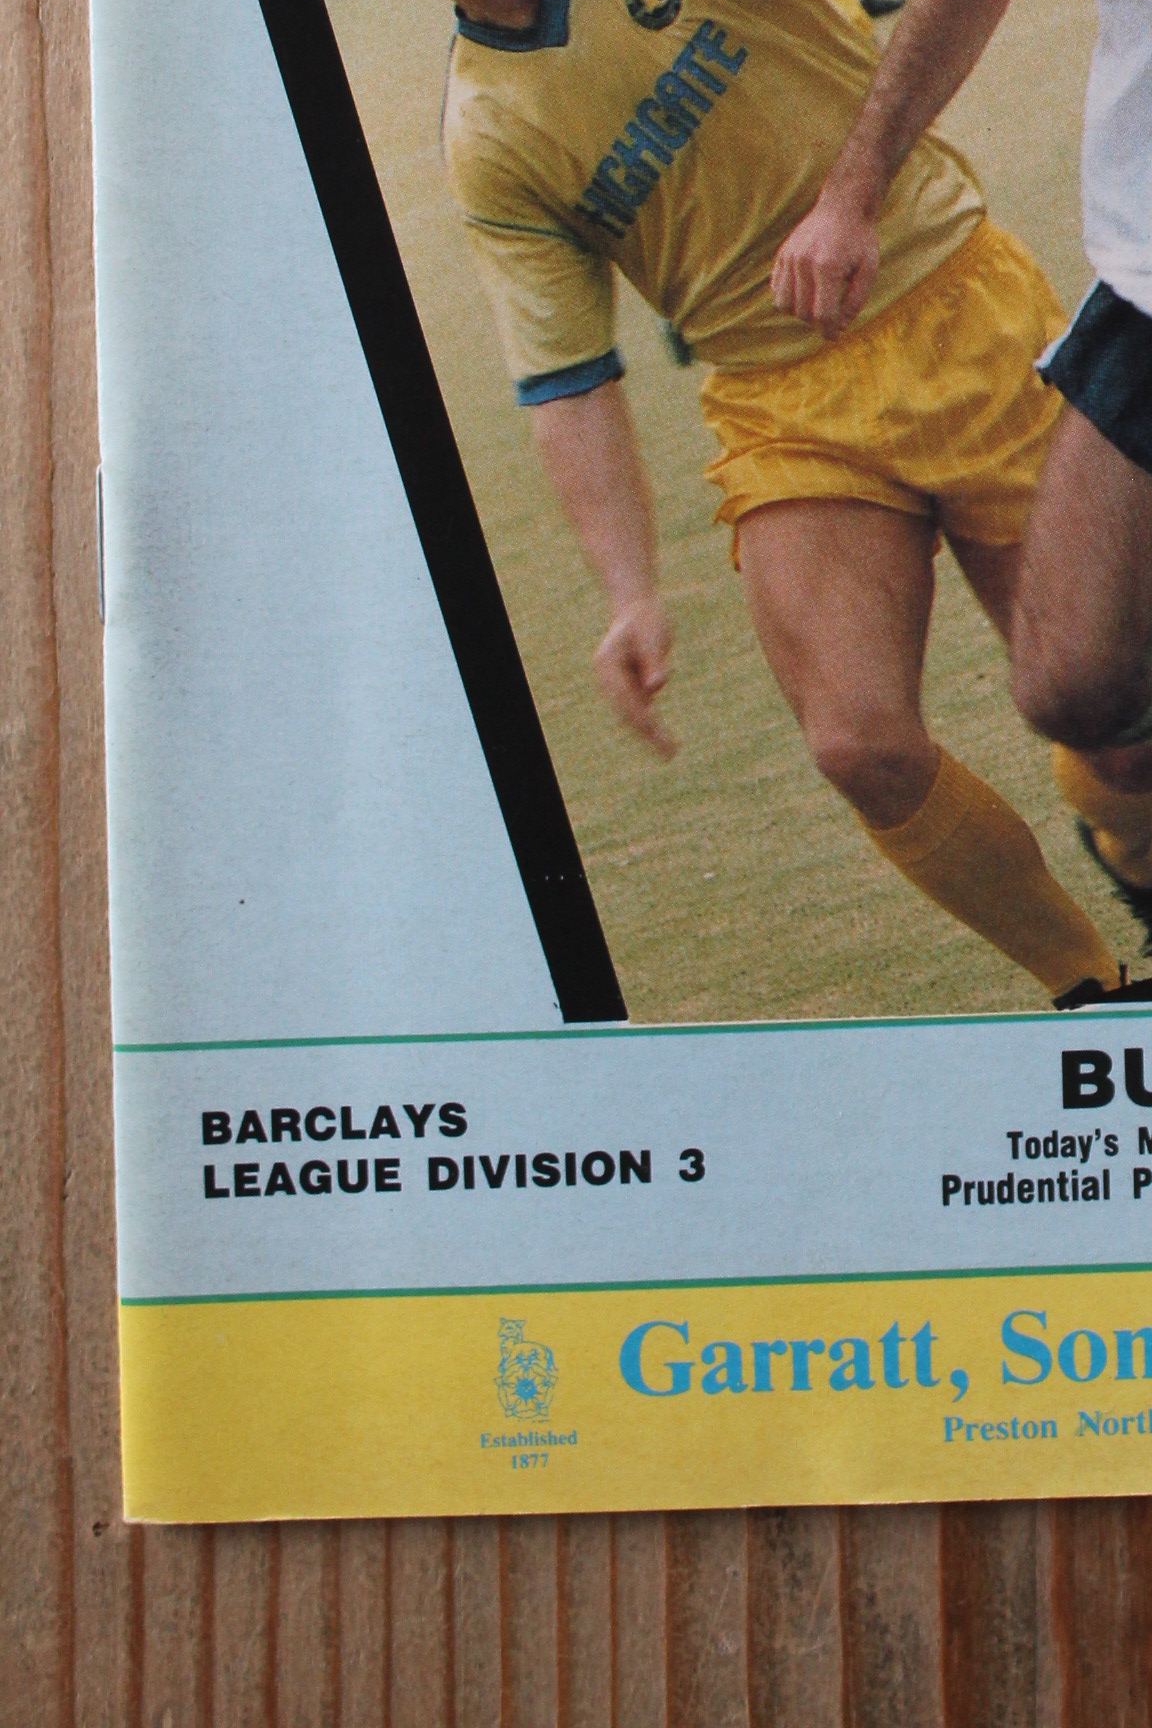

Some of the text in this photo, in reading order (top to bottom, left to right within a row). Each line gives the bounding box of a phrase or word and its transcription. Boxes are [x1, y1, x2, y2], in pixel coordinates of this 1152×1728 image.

[201, 1102, 468, 1146] BARCLAYS
[1006, 1128, 1119, 1165] Today's
[203, 1148, 706, 1200] LEAGUE DIVISION 3
[941, 1168, 1111, 1207] Prudential
[619, 1321, 969, 1402] Garratt,
[480, 1429, 578, 1449] Established
[943, 1416, 1058, 1443] Preston
[511, 1452, 549, 1470] 1877
